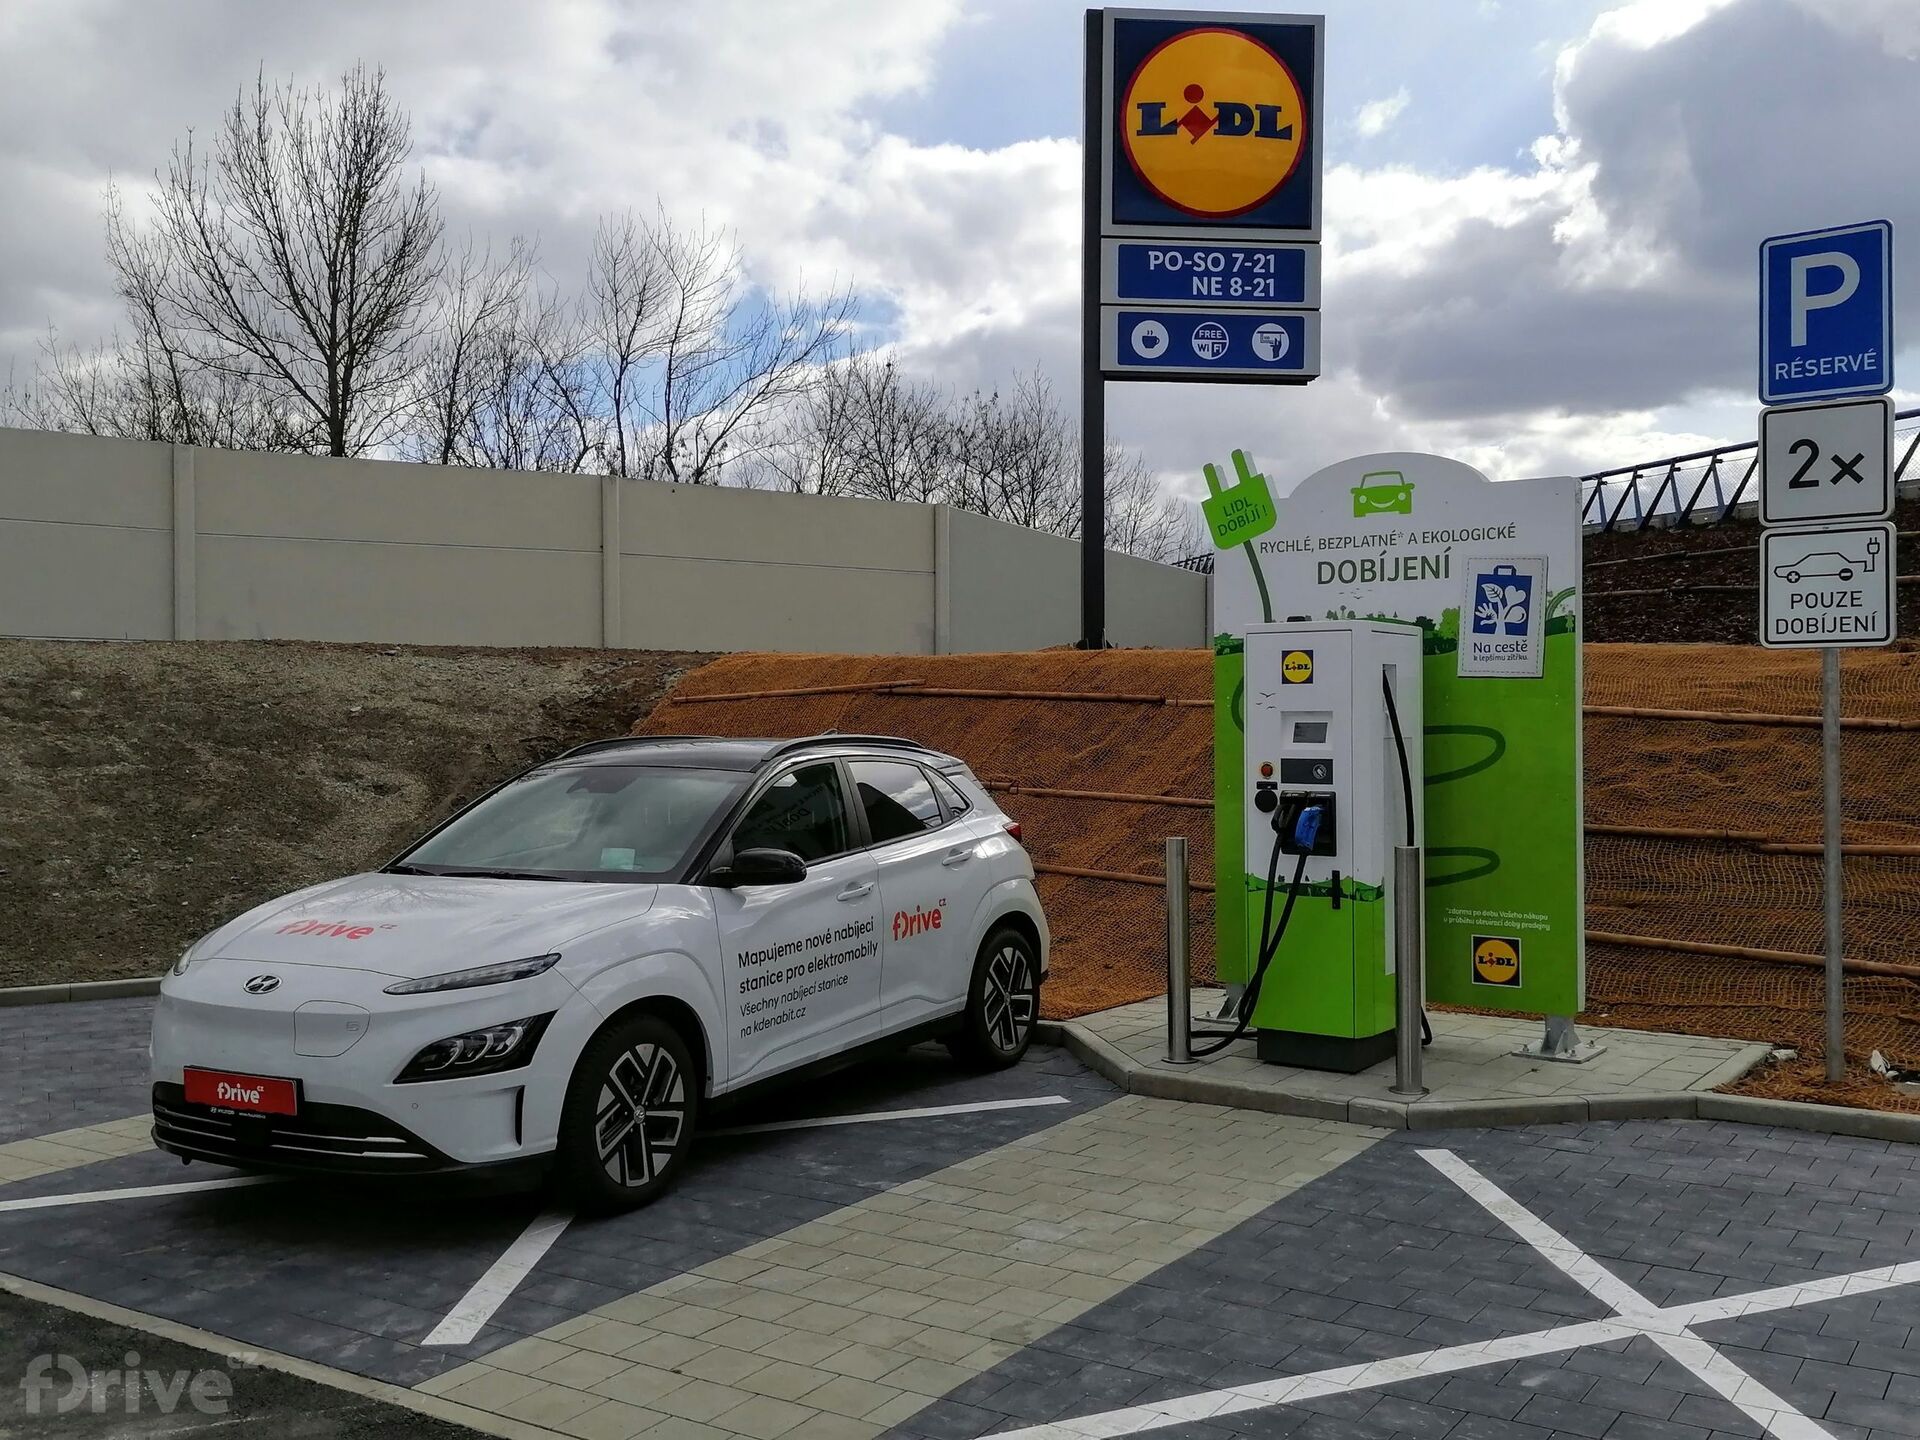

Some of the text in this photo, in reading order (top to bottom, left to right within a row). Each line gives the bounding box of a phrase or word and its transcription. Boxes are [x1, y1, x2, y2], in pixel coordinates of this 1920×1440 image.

[1148, 250, 1275, 273] PO-SO 7-21
[1192, 276, 1275, 297] NE 8-21
[1791, 251, 1861, 347] P
[1199, 330, 1222, 339] FREE
[1775, 348, 1877, 380] RÉSERVÉ
[1223, 497, 1253, 517] LIDL
[1260, 535, 1315, 554] RYCHLÉ,
[1408, 532, 1418, 545] A
[1422, 522, 1516, 544] EKOLOGICKÉ
[1317, 546, 1452, 585] DOBÍJENÍ
[1790, 591, 1863, 610] POUZE
[1776, 611, 1878, 635] DOBÍJENÍ
[1473, 639, 1528, 653] Na cestě
[738, 916, 874, 969] Mapujeme nové nabíjecí
[740, 941, 878, 994] stanice pro elektromobily
[740, 974, 849, 1017] Všechny nabíjecí stanice
[740, 1007, 807, 1038] na kdenabit.cz
